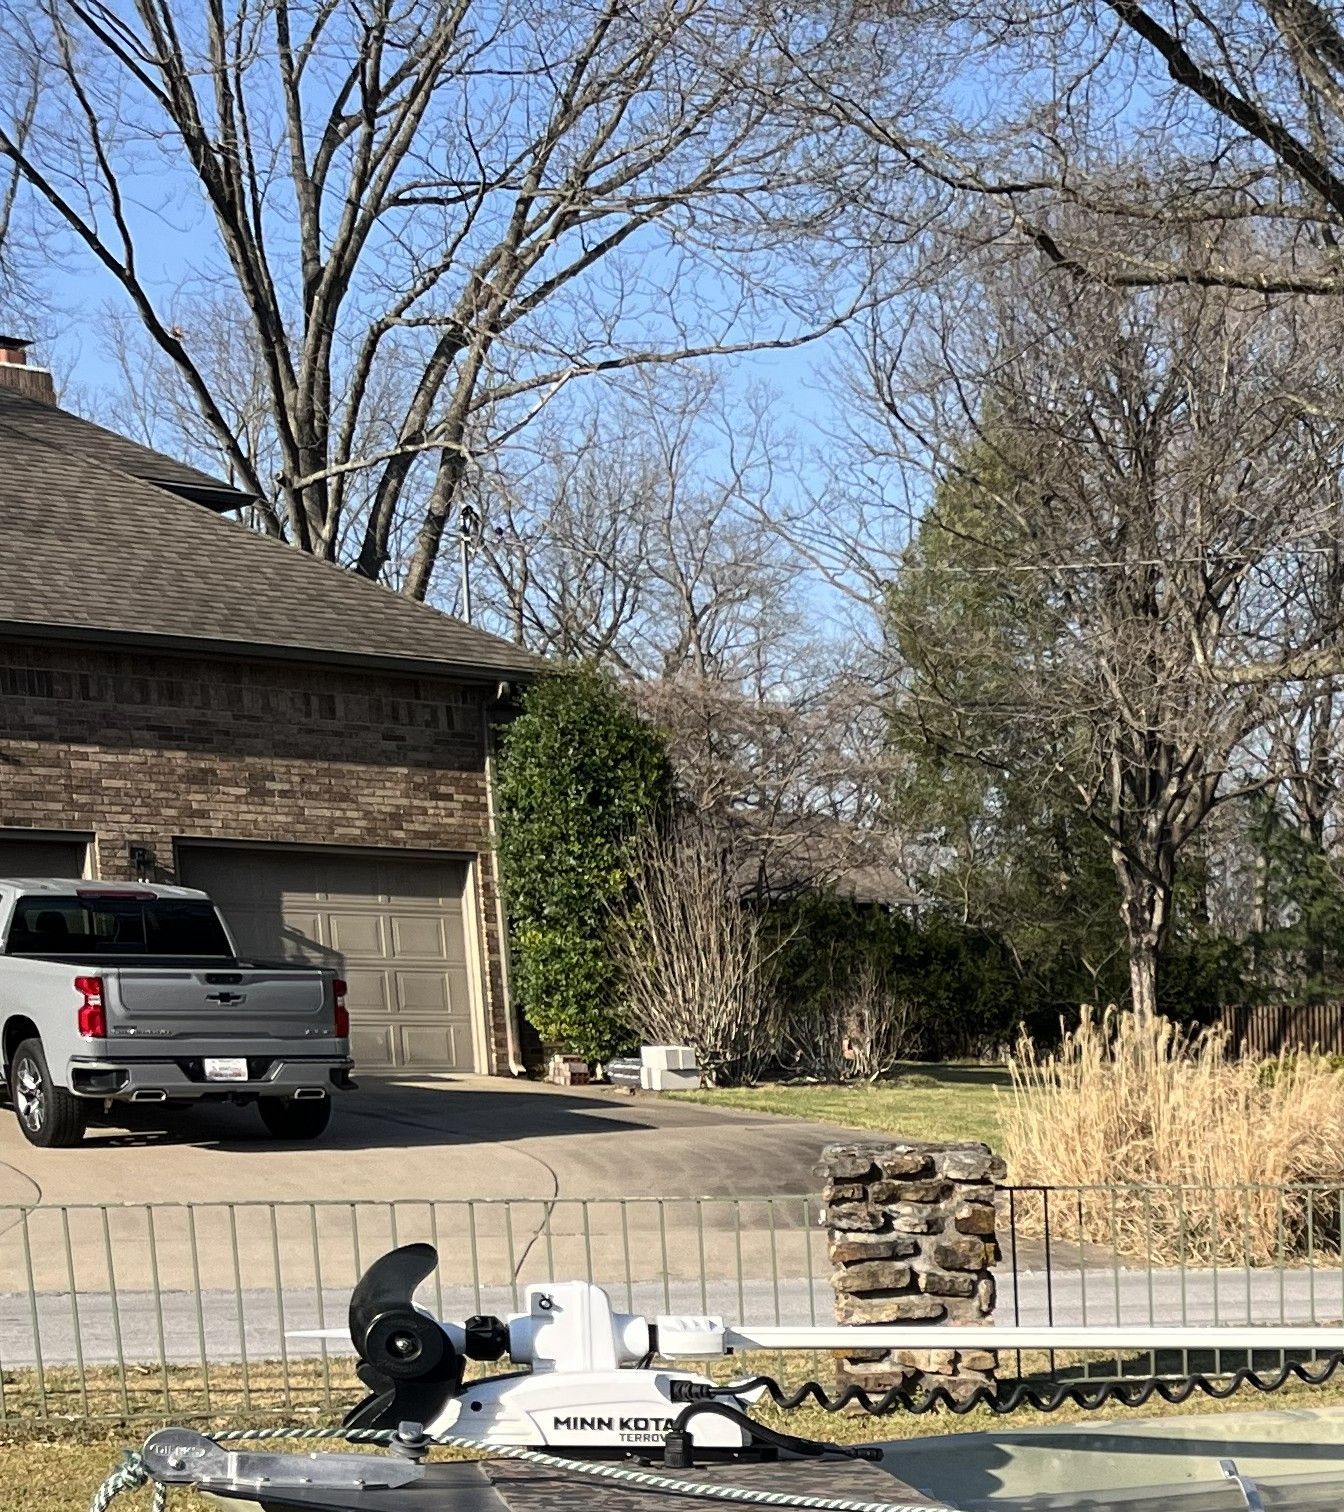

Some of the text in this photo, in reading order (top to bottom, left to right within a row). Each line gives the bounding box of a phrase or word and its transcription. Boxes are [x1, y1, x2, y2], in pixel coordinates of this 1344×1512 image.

[553, 1416, 675, 1431] MINN KOTA
[619, 1433, 667, 1443] TERROV
